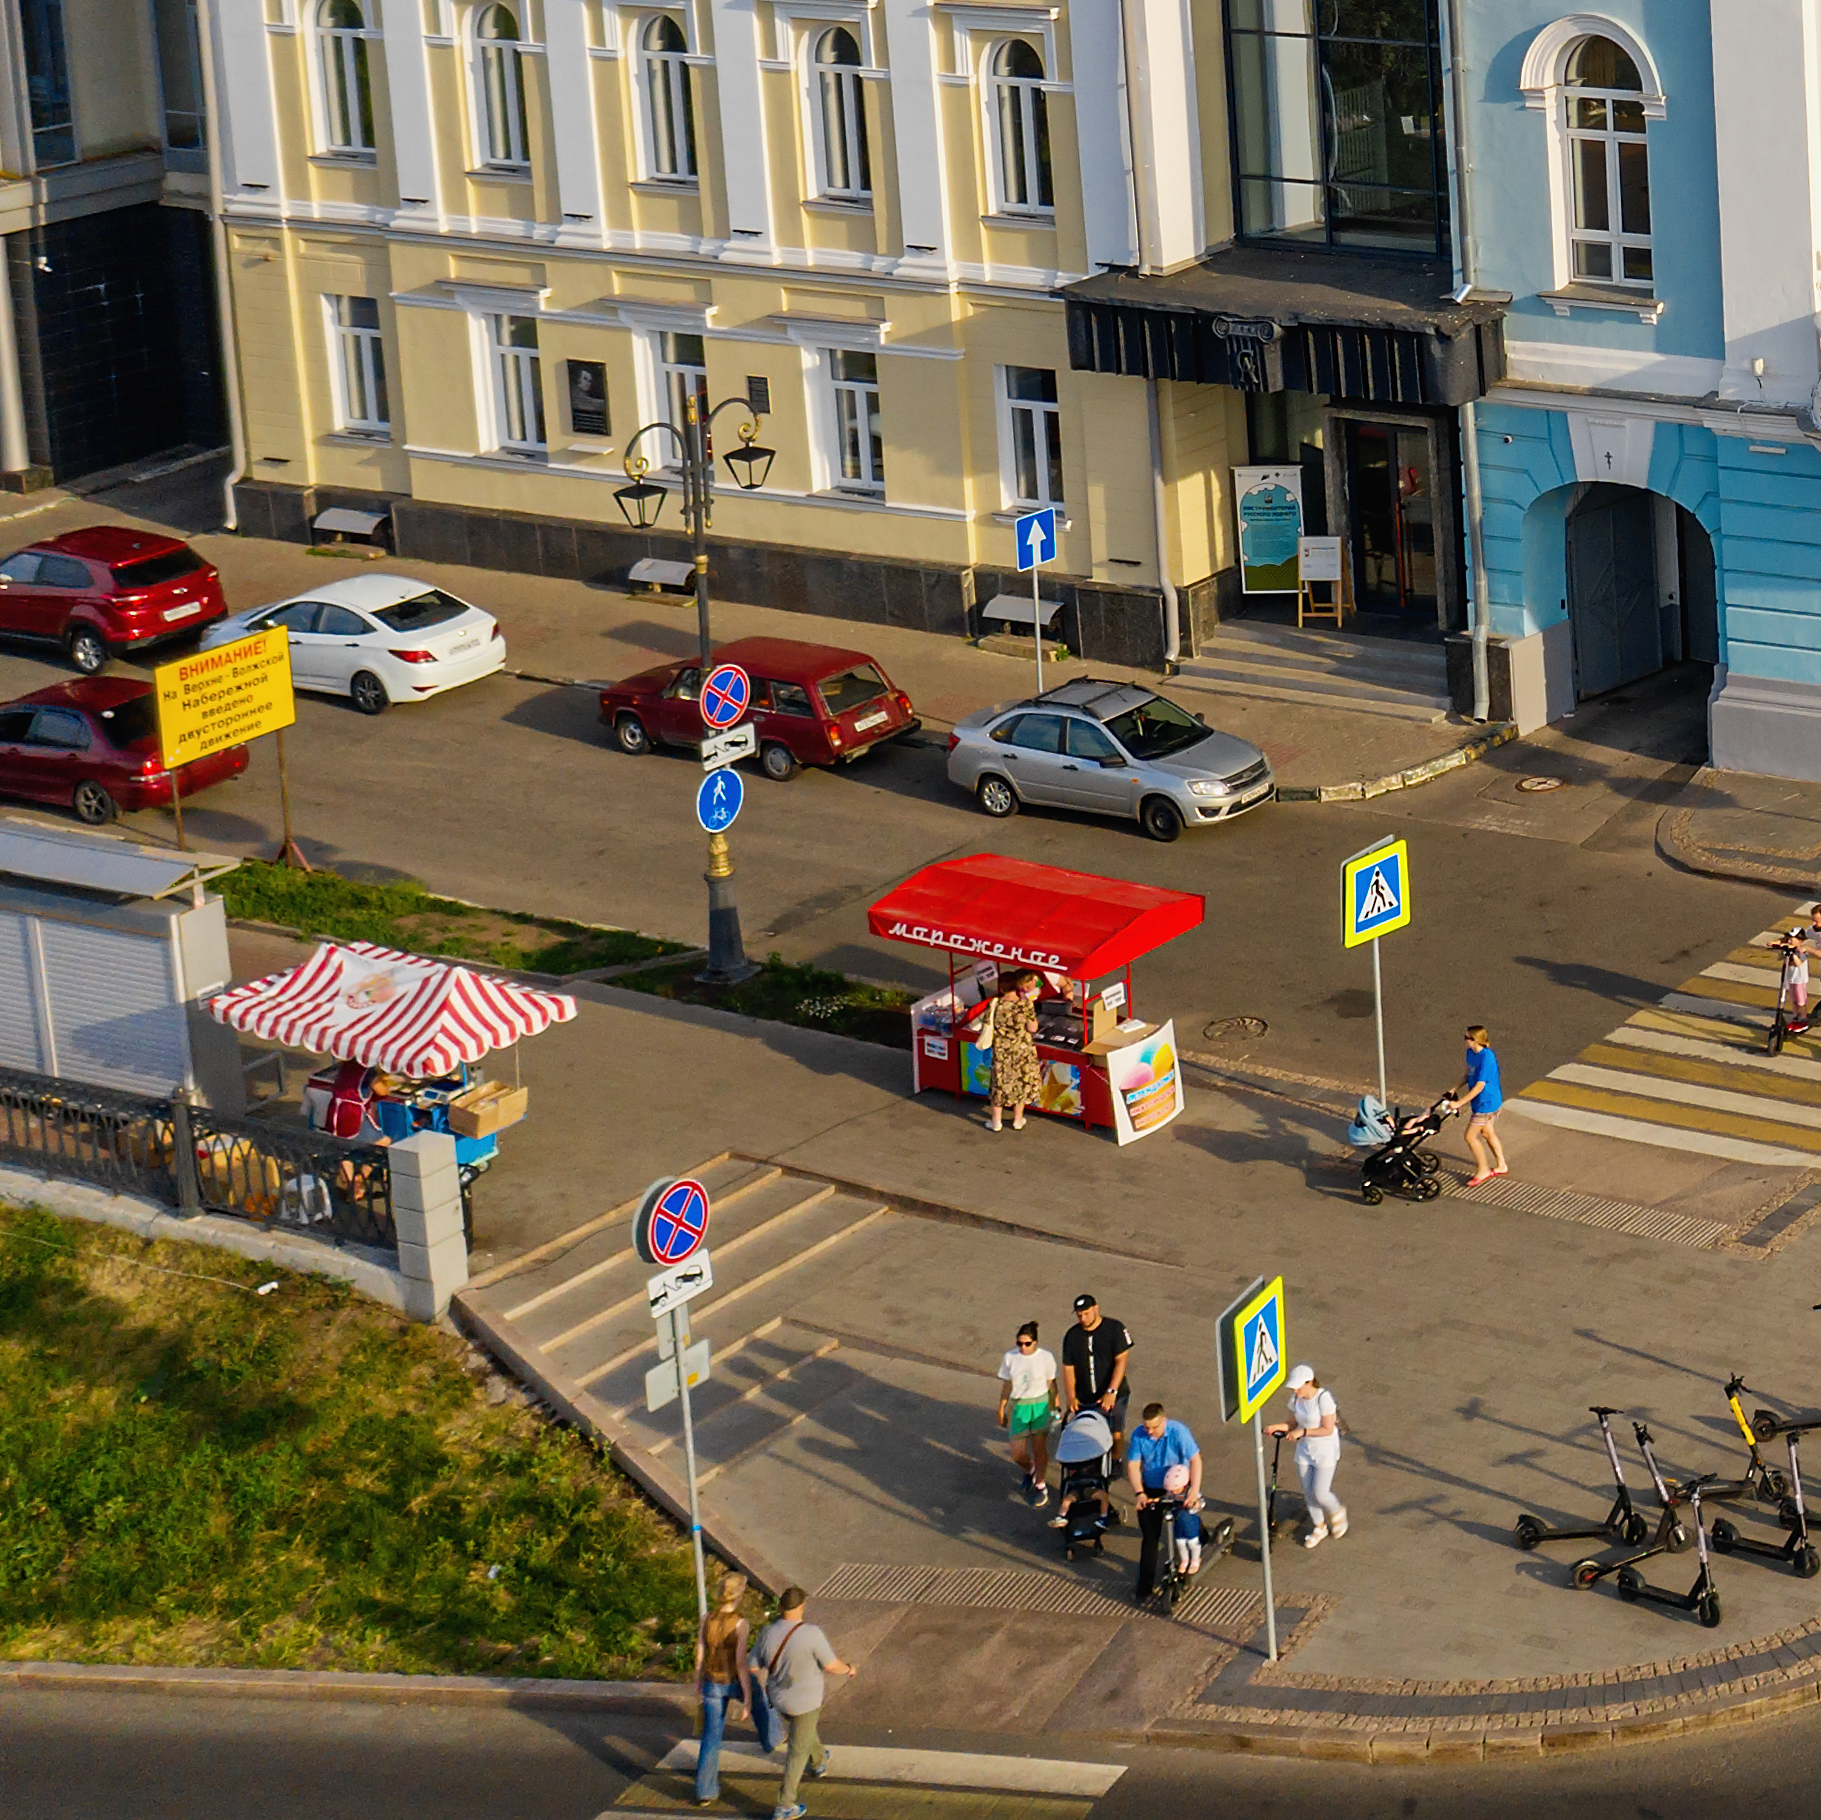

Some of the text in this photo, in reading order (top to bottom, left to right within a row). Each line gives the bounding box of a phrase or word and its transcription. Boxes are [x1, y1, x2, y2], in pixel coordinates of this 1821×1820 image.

[163, 690, 177, 702] На
[184, 675, 223, 695] Верхне
[232, 652, 284, 679] Волжской
[179, 639, 267, 681] ВНИМАНИЕ!
[182, 673, 269, 711] Набережной
[201, 694, 253, 720] введено
[178, 701, 273, 745] двустороннее
[200, 720, 262, 752] движение
